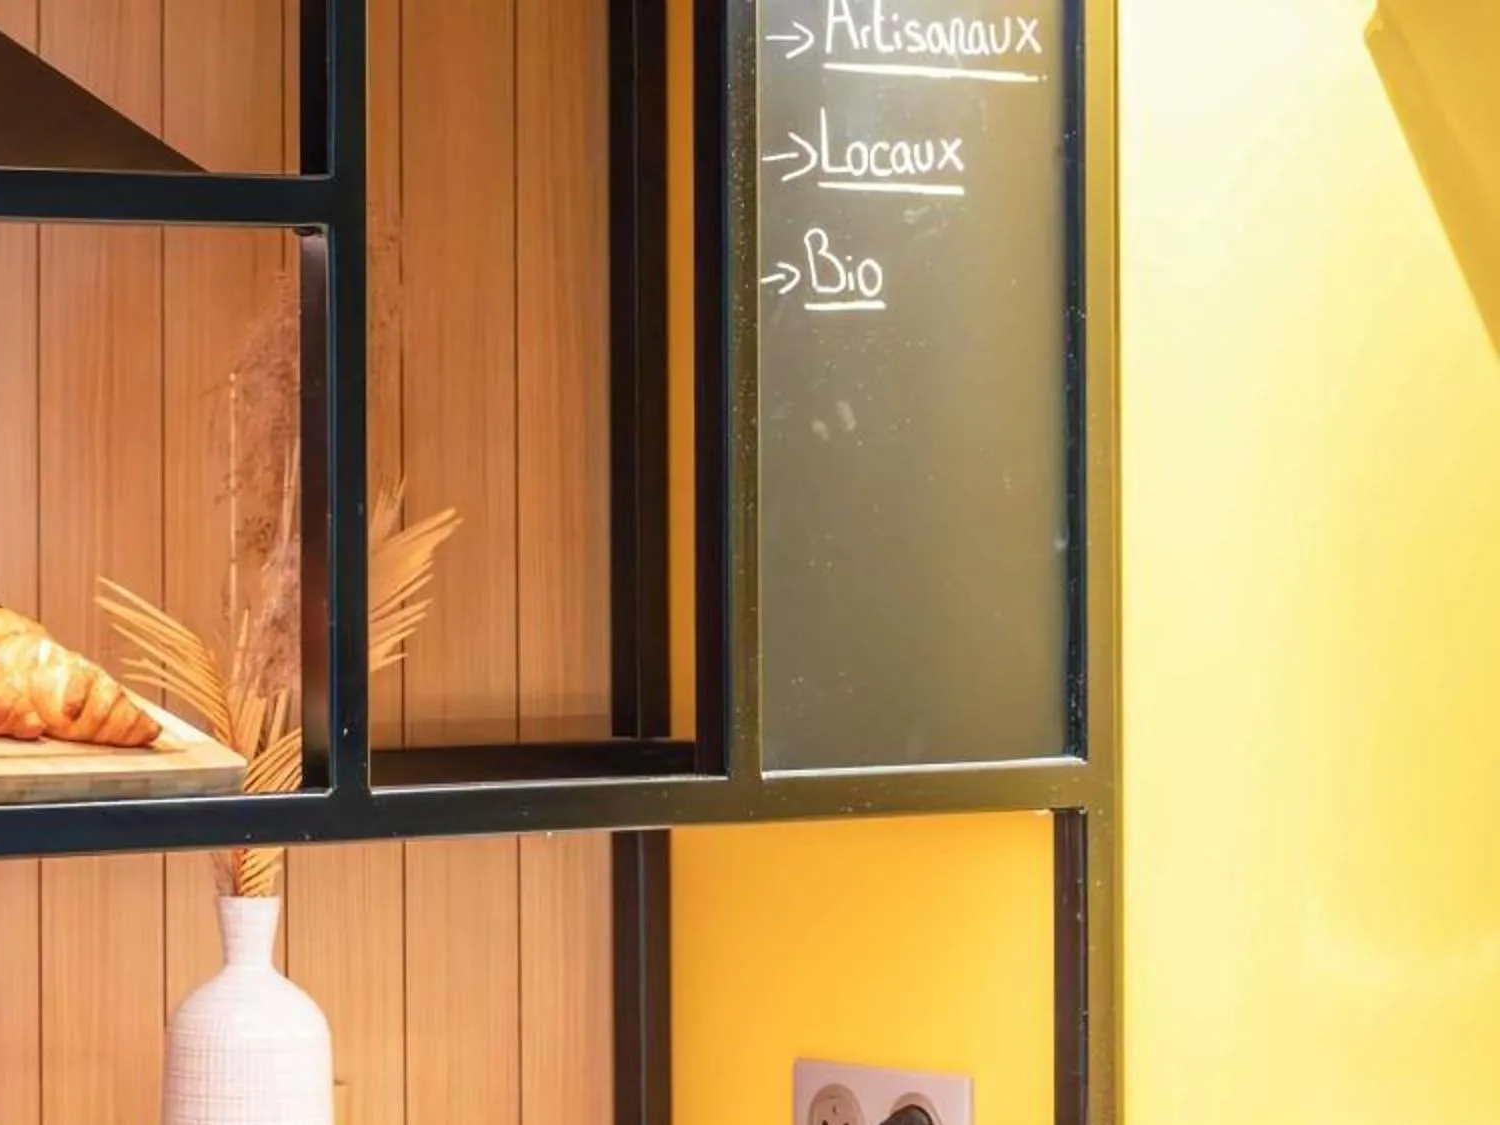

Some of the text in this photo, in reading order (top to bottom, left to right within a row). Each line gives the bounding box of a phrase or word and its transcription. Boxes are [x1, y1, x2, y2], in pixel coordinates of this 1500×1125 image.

[824, 0, 1042, 57] Artisanaux
[819, 106, 965, 177] Locaux
[803, 227, 884, 298] Bio
